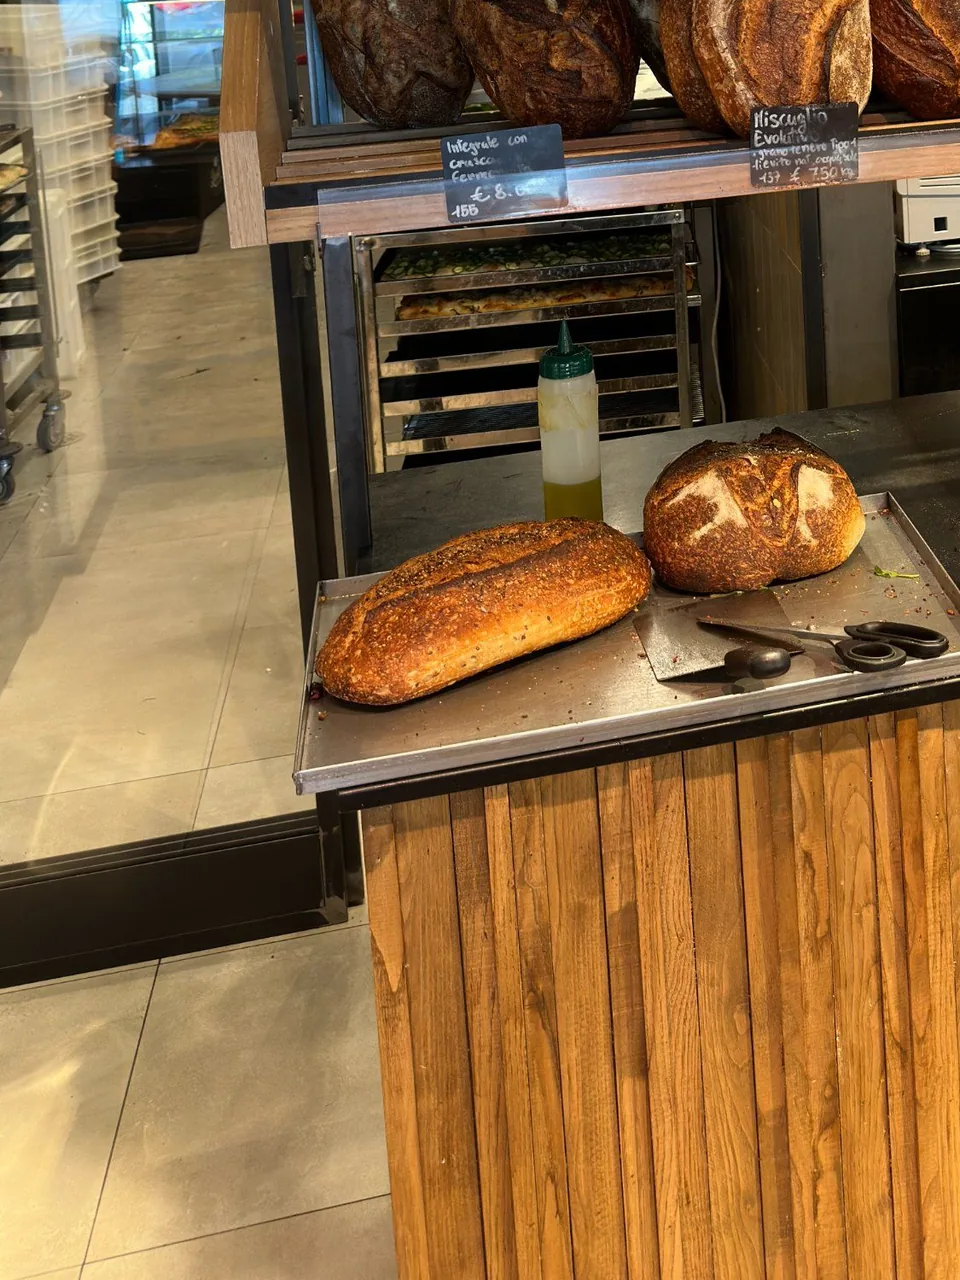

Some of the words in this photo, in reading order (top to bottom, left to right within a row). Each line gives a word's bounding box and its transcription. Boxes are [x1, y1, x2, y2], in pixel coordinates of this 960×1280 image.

[754, 107, 828, 134] Miscuglio
[447, 136, 499, 156] Integrale
[508, 134, 527, 146] con
[758, 148, 788, 161] grano
[792, 144, 827, 155] tenero
[754, 157, 791, 170] lievito
[759, 171, 780, 183] 137
[470, 186, 490, 202] €
